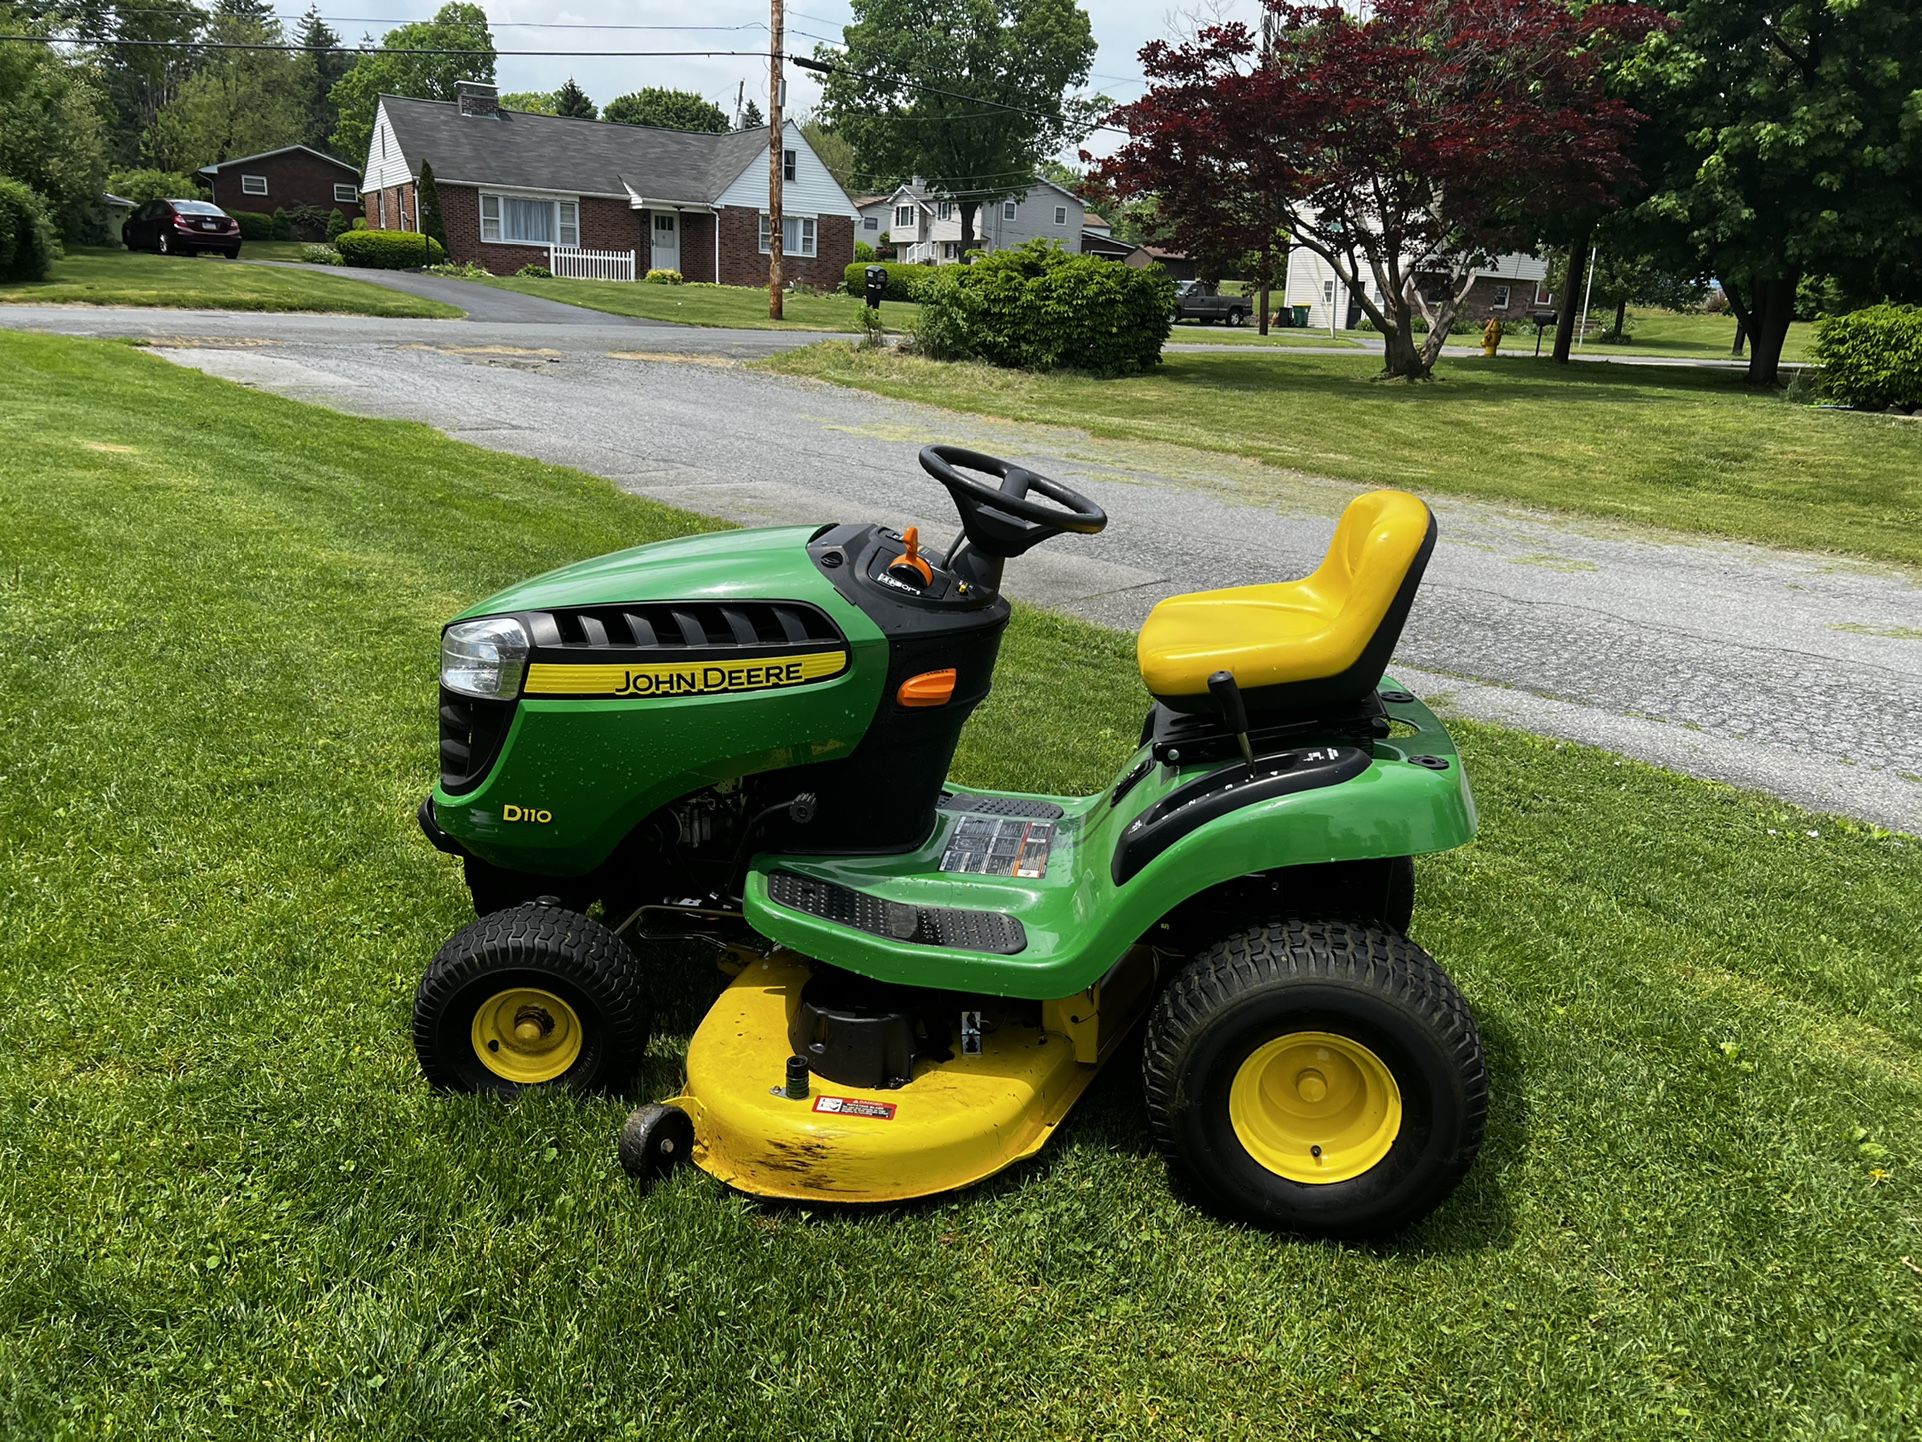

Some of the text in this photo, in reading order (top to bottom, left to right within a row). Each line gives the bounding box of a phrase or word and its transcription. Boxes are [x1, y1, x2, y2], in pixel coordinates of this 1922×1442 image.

[615, 662, 803, 693] JOHN DEERE
[503, 804, 552, 823] D110
